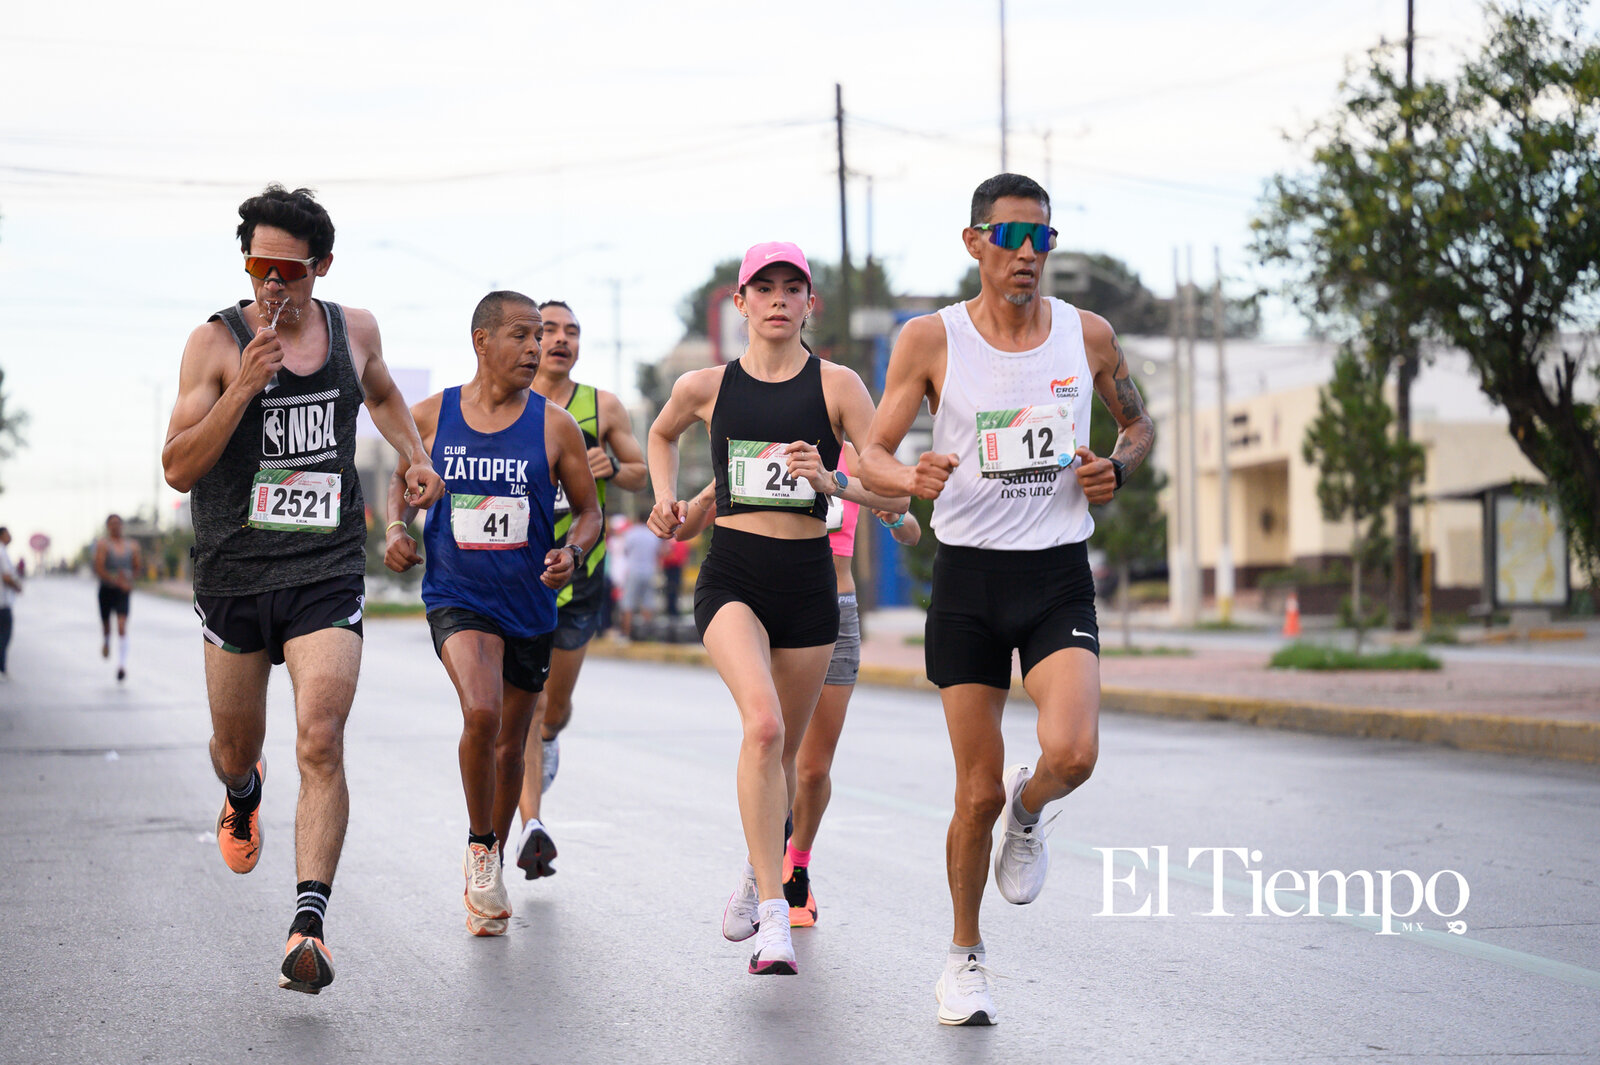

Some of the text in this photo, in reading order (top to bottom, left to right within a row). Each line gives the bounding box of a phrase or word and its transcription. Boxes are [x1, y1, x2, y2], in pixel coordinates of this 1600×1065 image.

[288, 402, 337, 454] NBA
[444, 446, 467, 455] CLUB
[1022, 427, 1054, 459] 12
[443, 456, 529, 483] ZATOPEK
[765, 462, 797, 491] 24
[510, 483, 526, 496] ZAC
[1001, 486, 1057, 499] nos une.
[271, 487, 331, 520] 2521
[483, 513, 509, 537] 41
